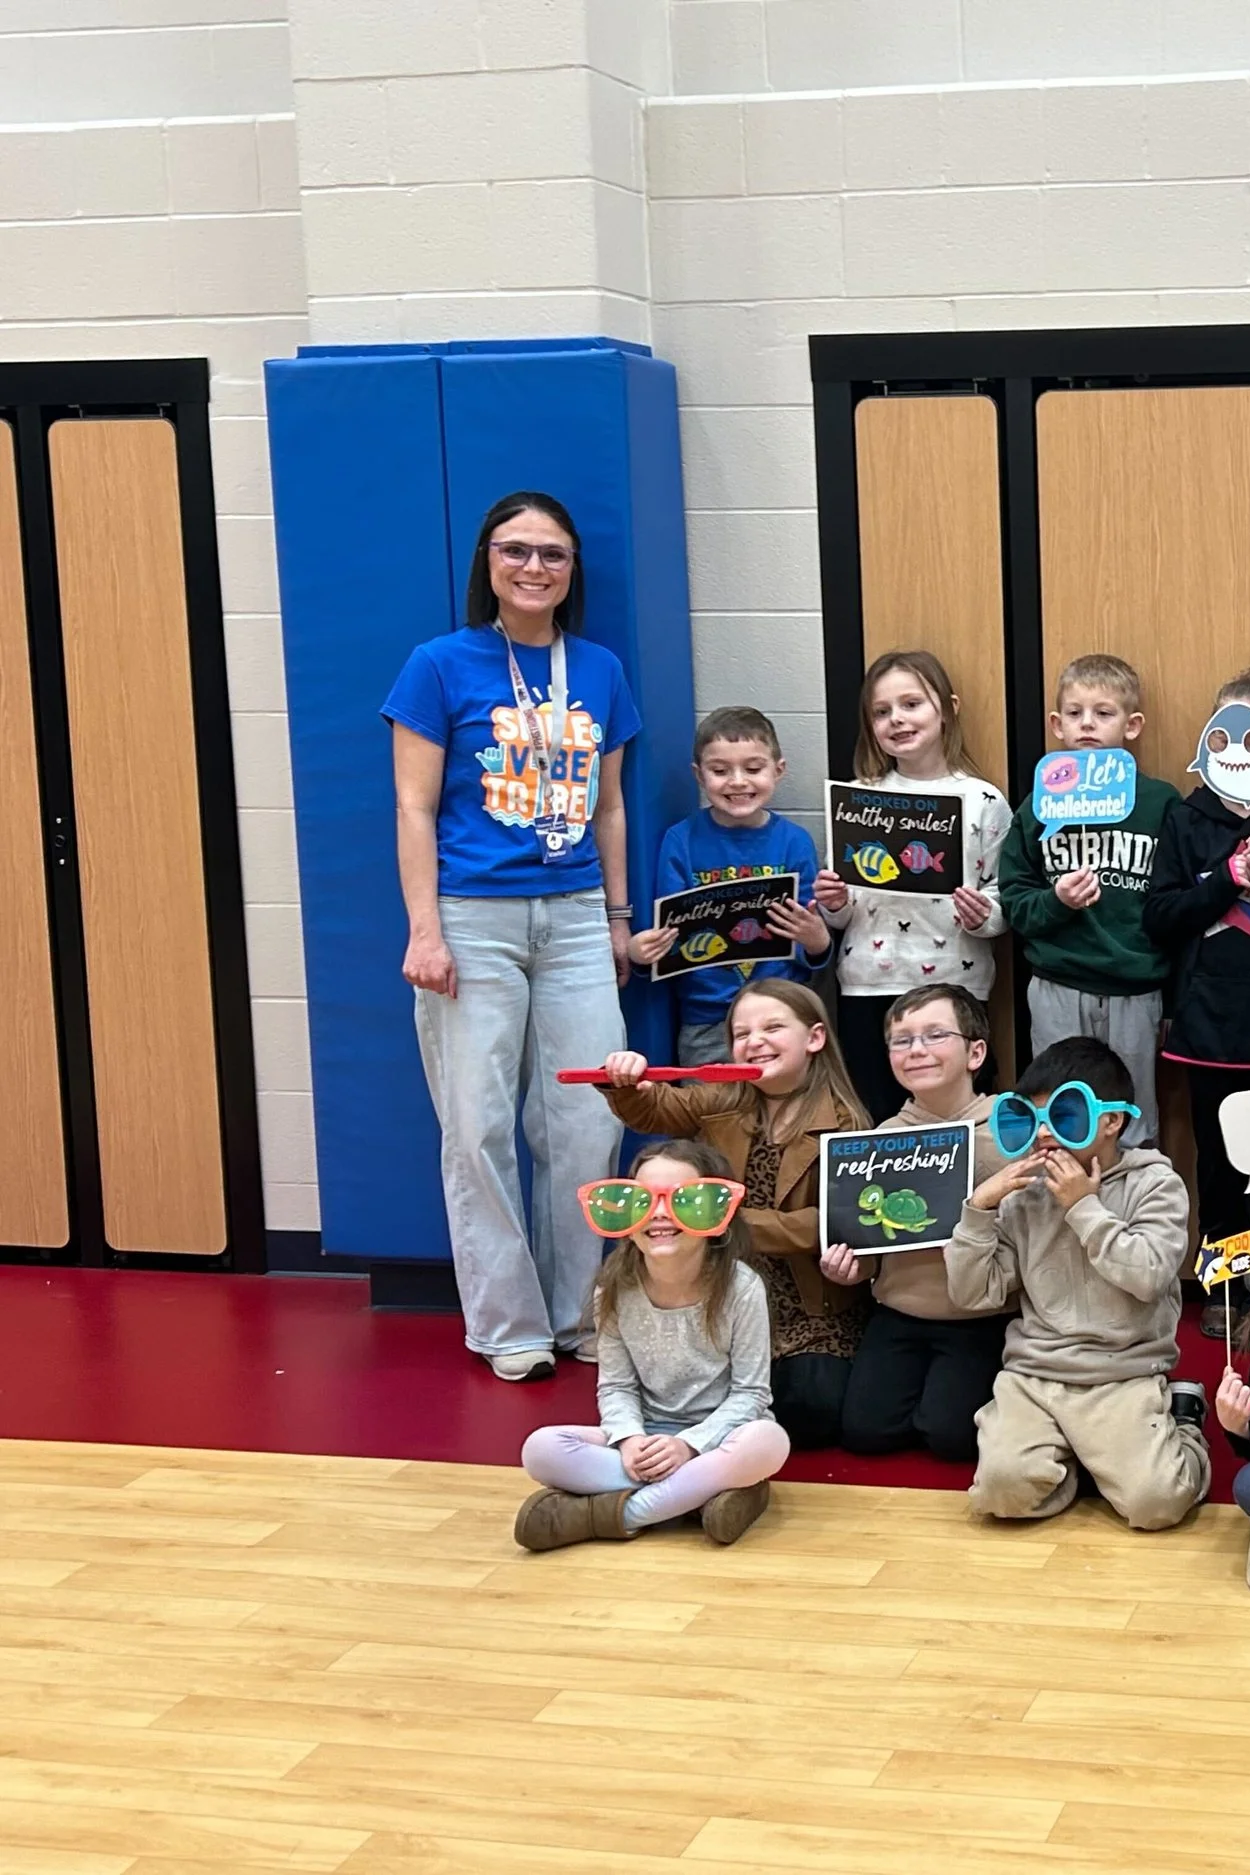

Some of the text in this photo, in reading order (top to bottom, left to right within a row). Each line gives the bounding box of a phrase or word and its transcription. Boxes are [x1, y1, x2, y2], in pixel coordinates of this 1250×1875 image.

[510, 743, 590, 783] VBE
[1077, 752, 1126, 791] Let's
[851, 791, 938, 811] HOOKED ON
[1039, 792, 1126, 819] Shellebrate!
[835, 802, 957, 835] healthy smiles!
[691, 864, 786, 886] SUPER MARI
[682, 883, 770, 907] HOOKED ON
[665, 900, 726, 928] healthy
[831, 1131, 964, 1156] KEEP YOUR TEETH
[836, 1143, 959, 1181] reef-reshing!
